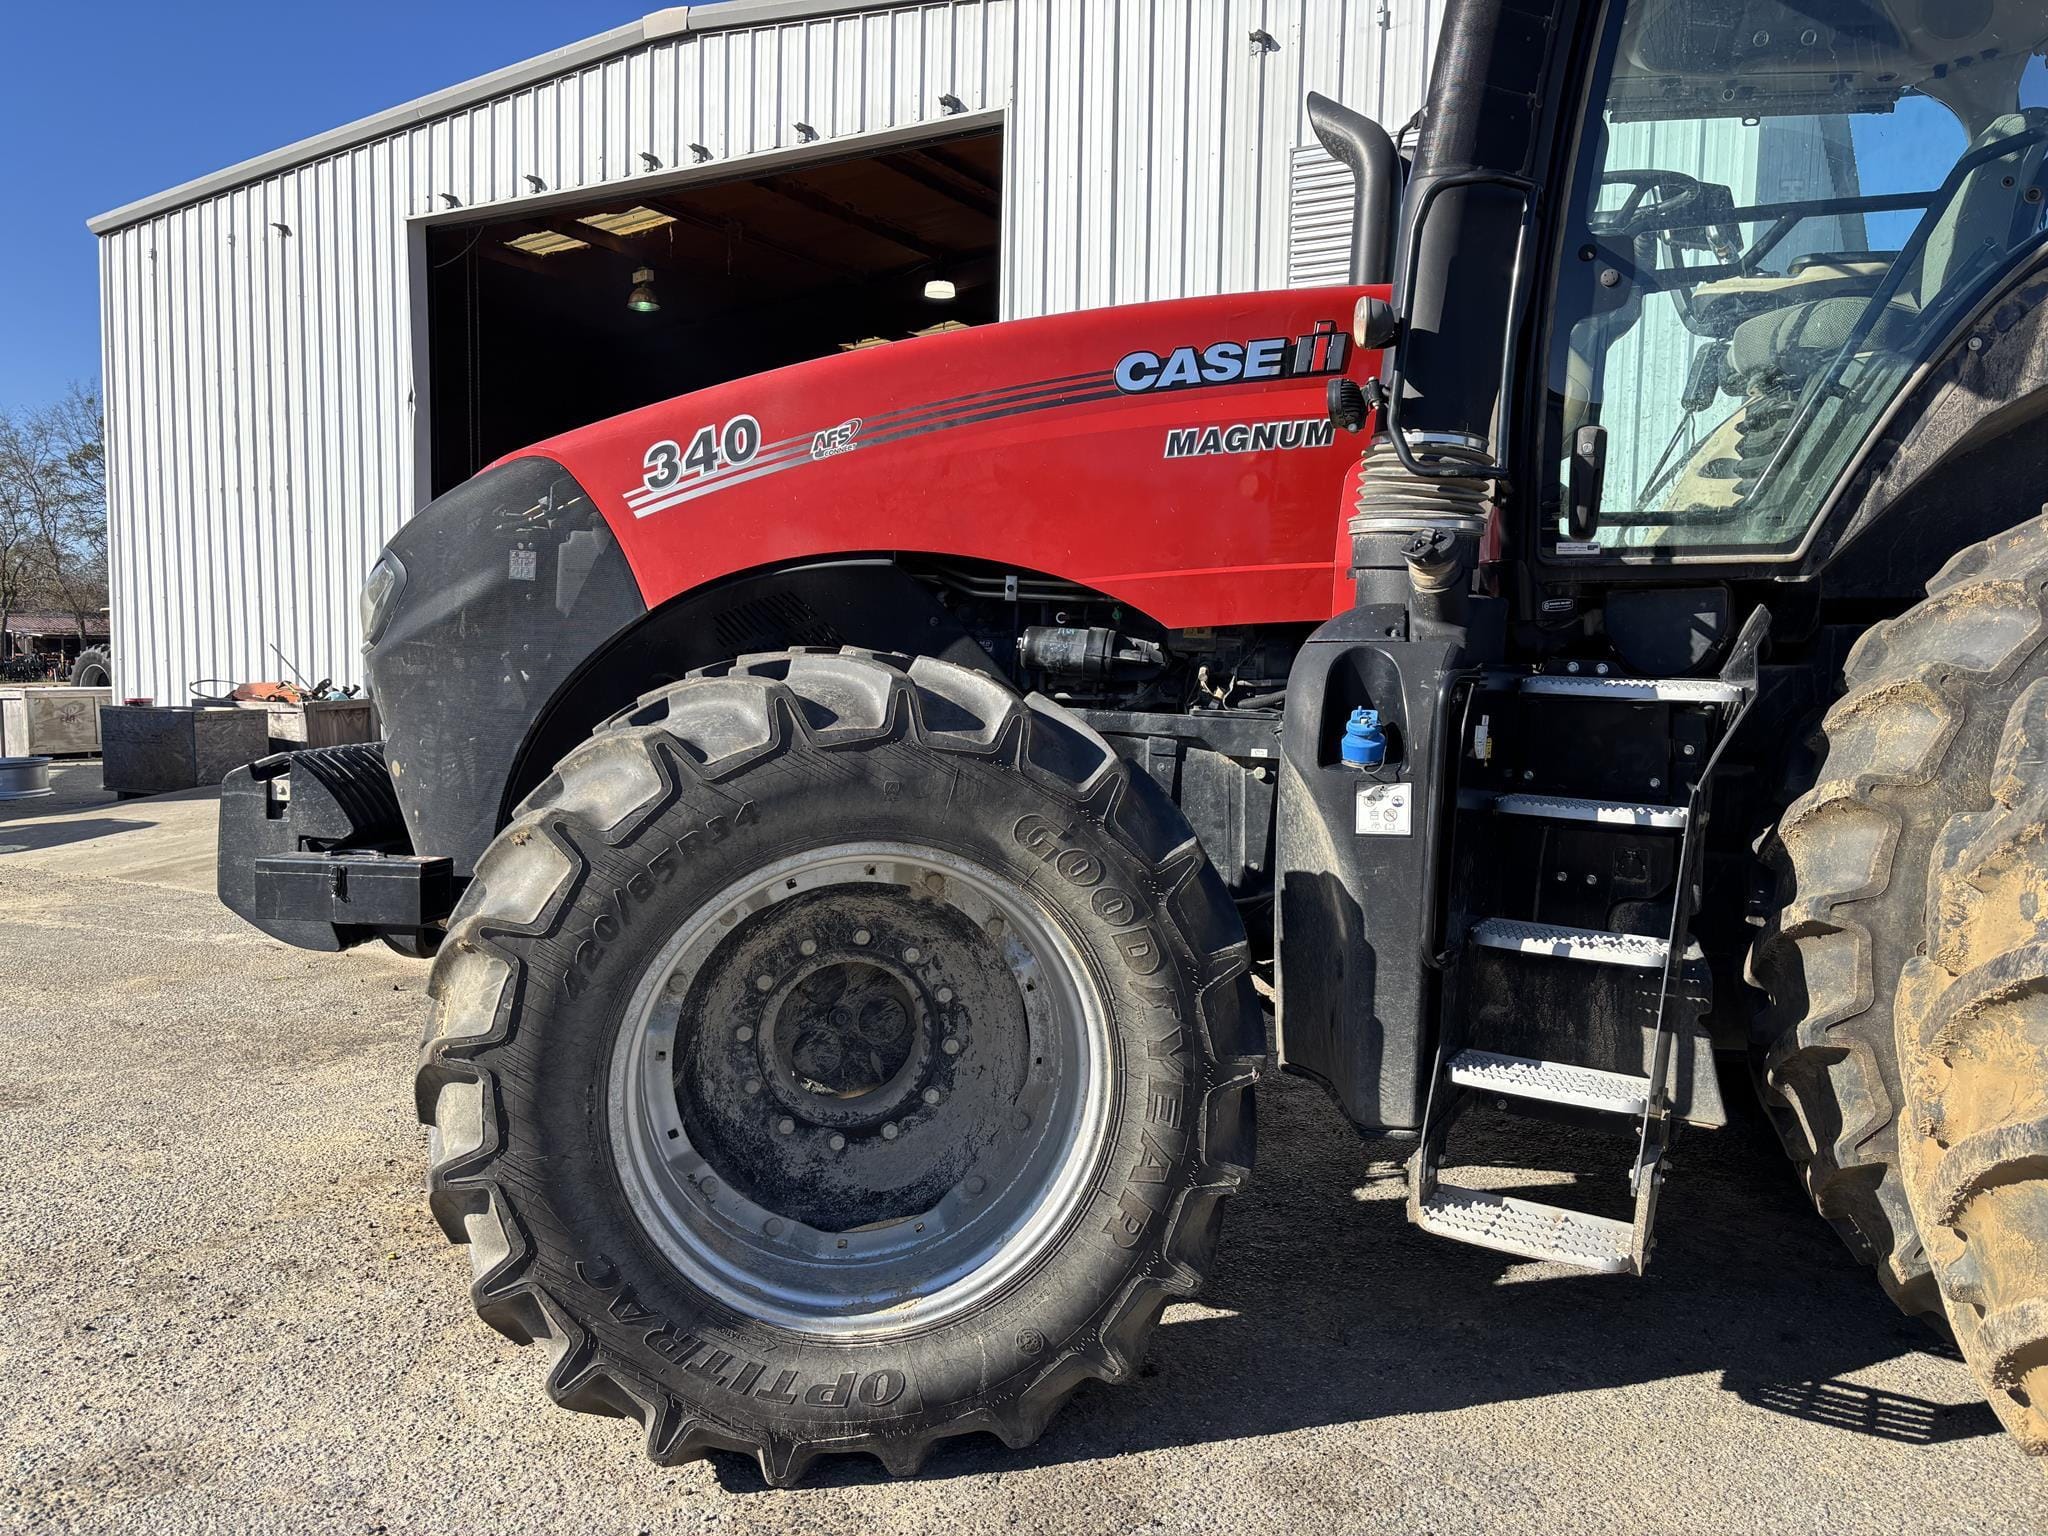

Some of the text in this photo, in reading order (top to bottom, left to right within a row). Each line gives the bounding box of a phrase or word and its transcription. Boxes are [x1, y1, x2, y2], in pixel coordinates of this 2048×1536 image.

[1114, 337, 1287, 395] CASE
[643, 414, 761, 492] 340
[810, 424, 852, 454] AFS
[1163, 419, 1337, 459] MAGNUM
[1012, 813, 1185, 1249] GOODYEAR
[575, 1254, 906, 1409] OPTITRAC
